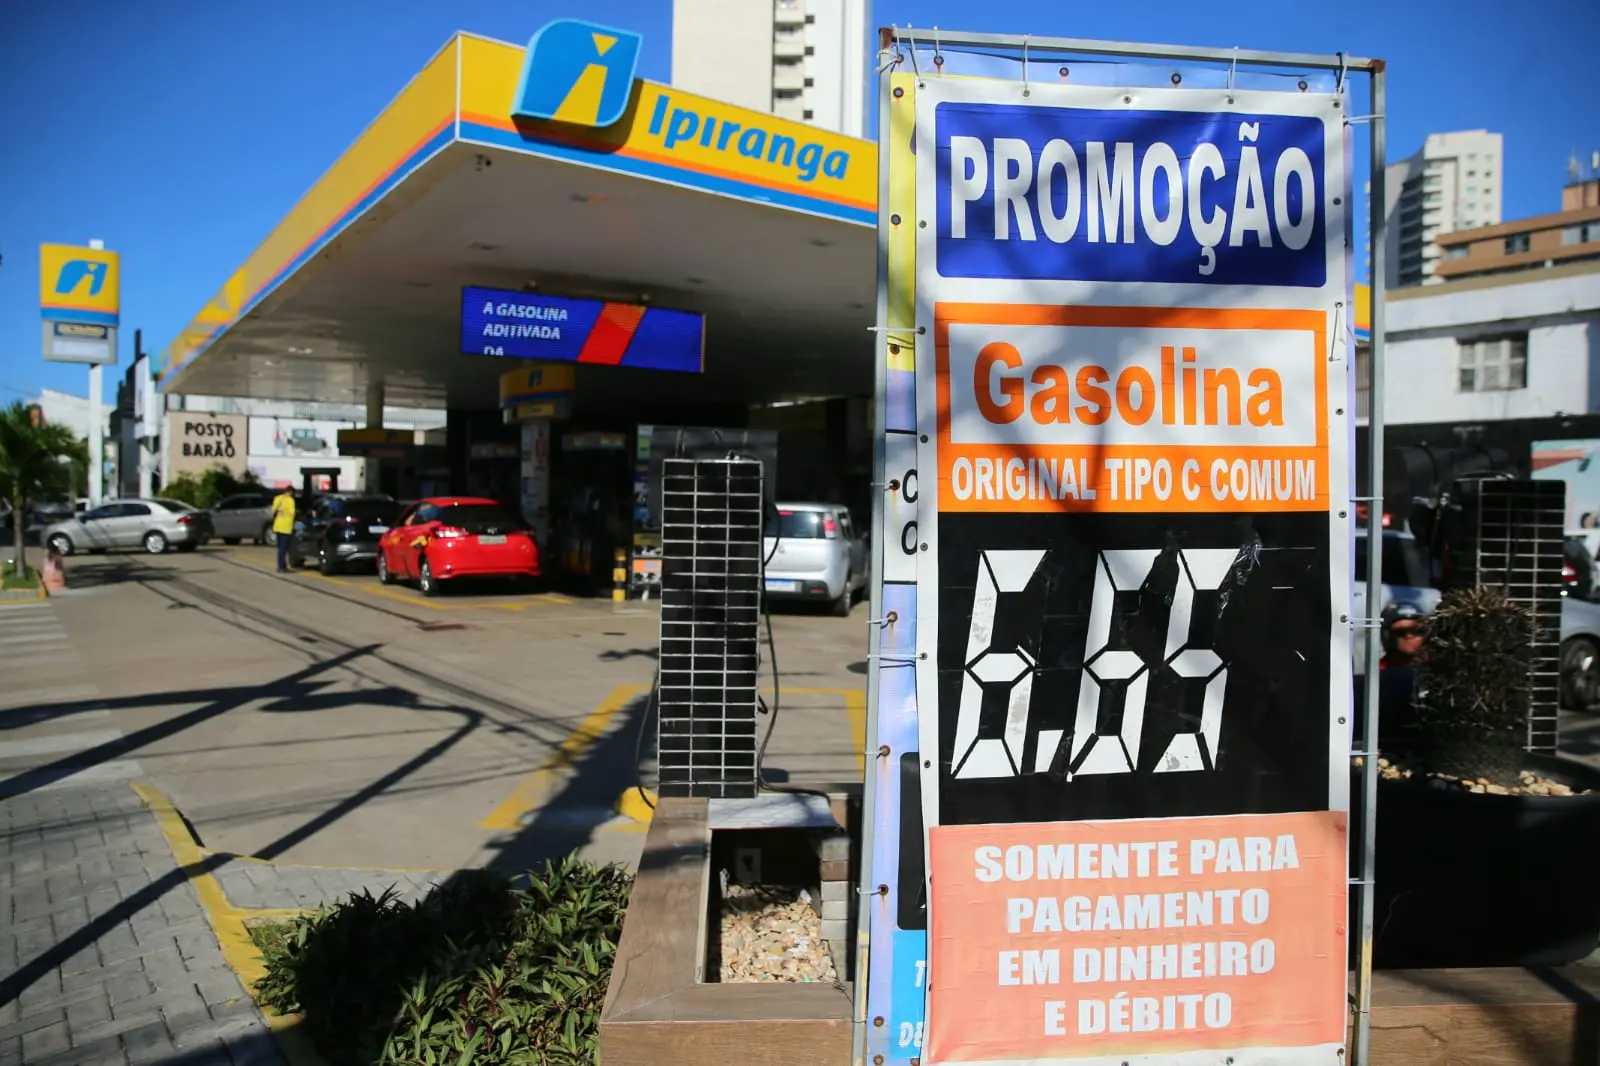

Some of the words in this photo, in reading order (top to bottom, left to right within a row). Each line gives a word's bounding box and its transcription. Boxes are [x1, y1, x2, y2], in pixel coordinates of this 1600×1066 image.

[950, 121, 1315, 275] PROMOÇÃO
[483, 301, 493, 315] A
[496, 303, 568, 321] GASOLINA
[483, 323, 560, 340] ADITIVADA
[973, 341, 1284, 427] Gasolina
[182, 440, 235, 458] BARÃO
[184, 421, 233, 438] POSTO
[952, 457, 1097, 502] ORIGINAL
[1105, 458, 1172, 501] TIPO
[1182, 459, 1200, 502] C
[1210, 459, 1316, 502] COMUM
[974, 841, 1179, 883] SOMENTE
[1190, 834, 1299, 875] PARA
[1007, 889, 1270, 933] PAGAMENTO
[998, 949, 1060, 986] EM
[1073, 939, 1275, 984] DINHEIRO
[1044, 1000, 1066, 1036] E
[1078, 992, 1232, 1035] DÉBITO
